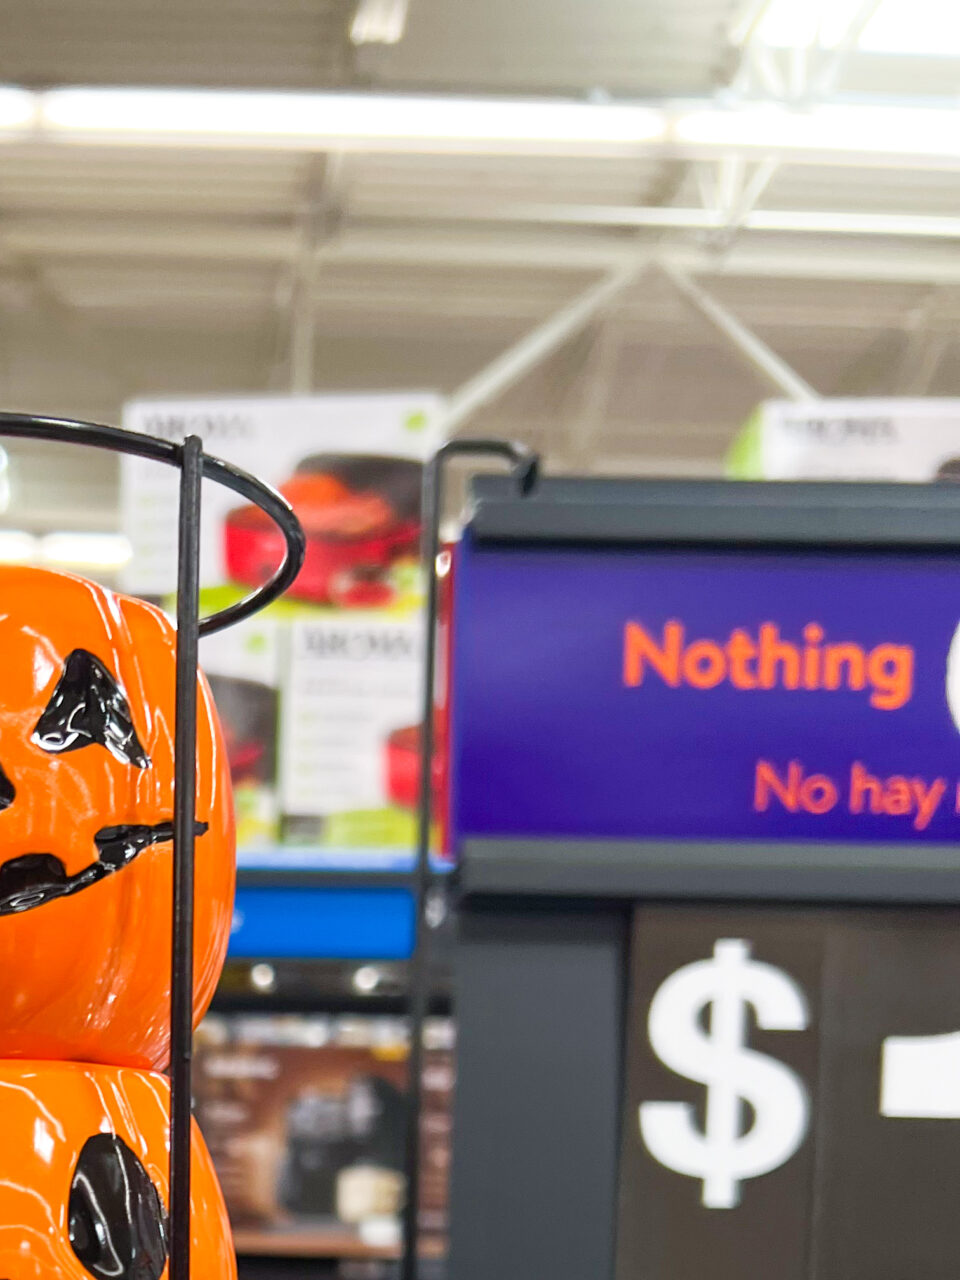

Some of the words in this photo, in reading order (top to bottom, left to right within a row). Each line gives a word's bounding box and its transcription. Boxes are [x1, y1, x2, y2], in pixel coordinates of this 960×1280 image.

[622, 619, 914, 710] Nothing
[752, 757, 838, 814] No
[848, 760, 947, 831] hay
